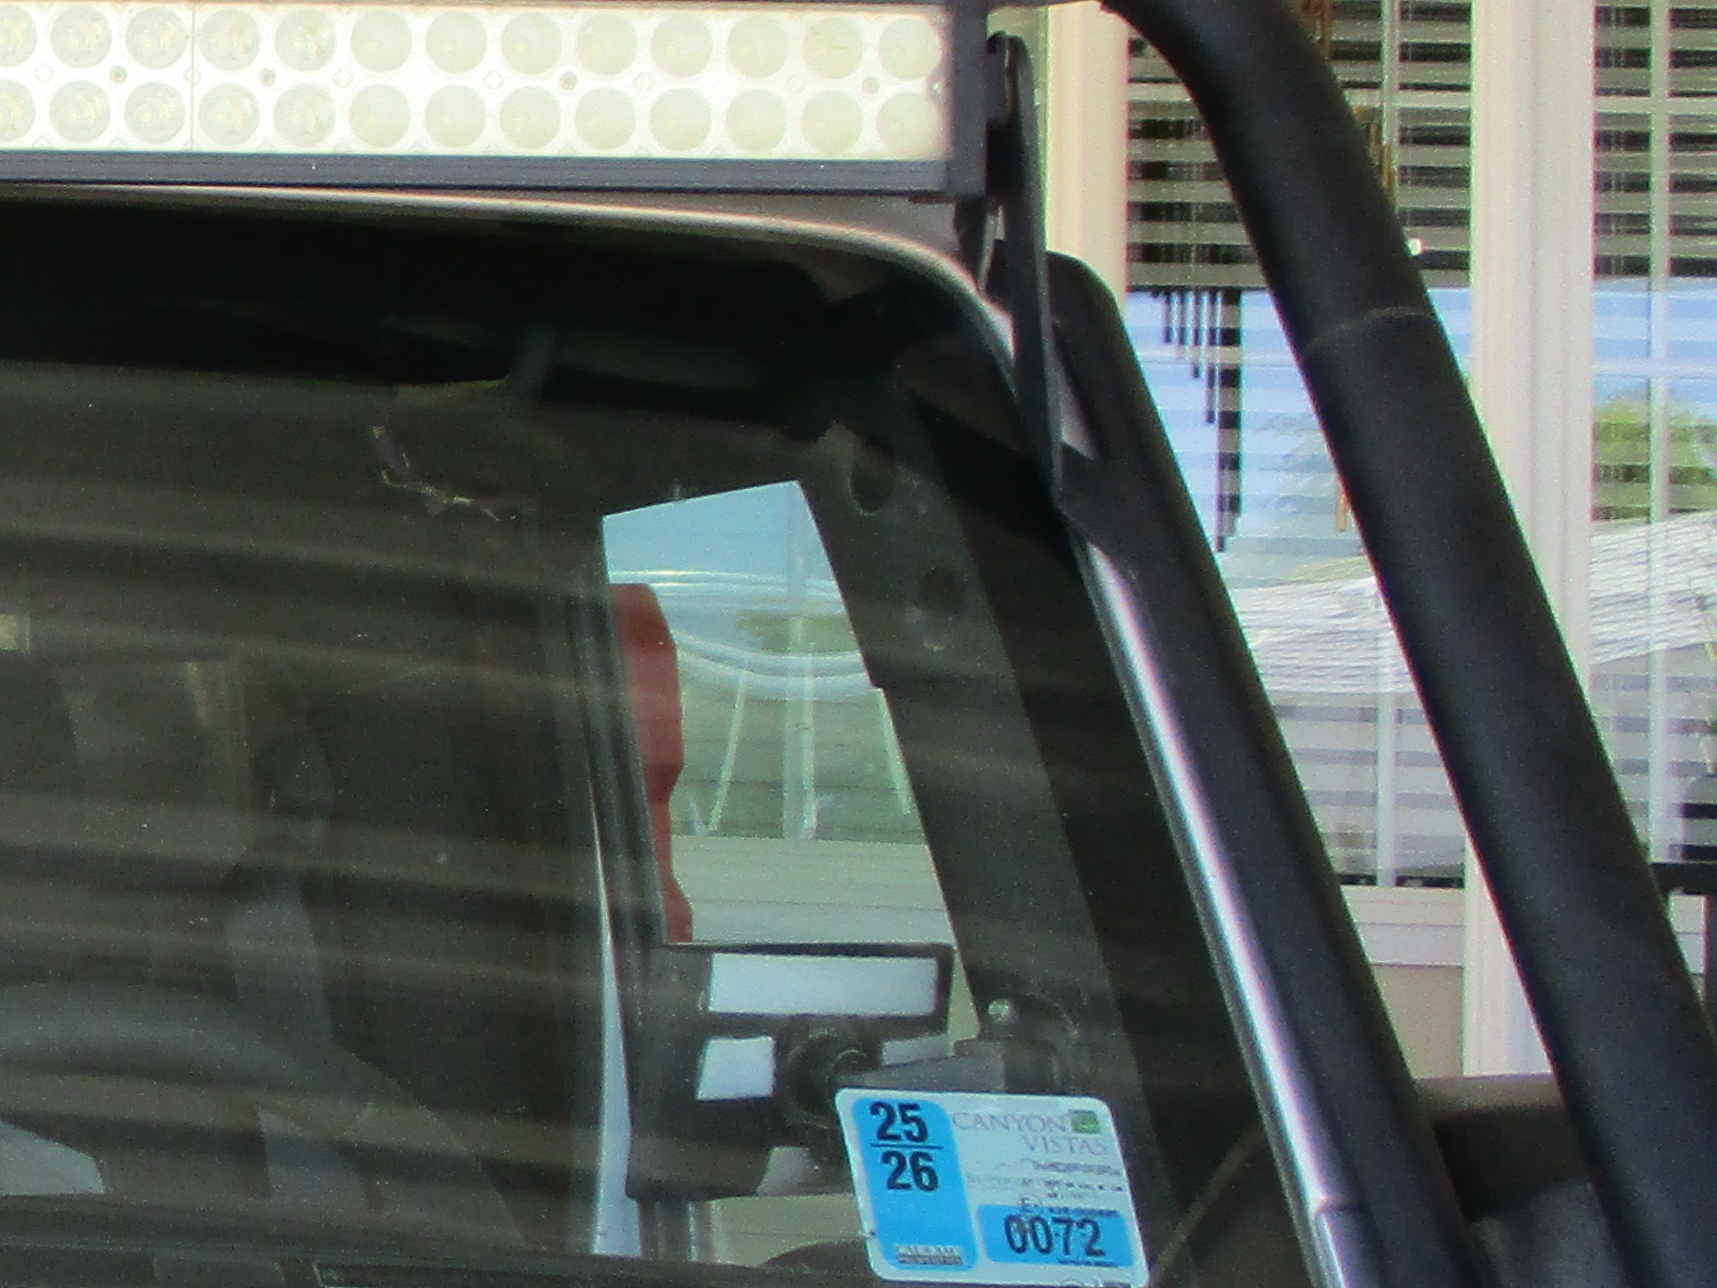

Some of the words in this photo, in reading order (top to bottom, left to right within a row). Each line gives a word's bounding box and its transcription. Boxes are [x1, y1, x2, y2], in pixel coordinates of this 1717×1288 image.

[870, 1102, 928, 1142] 25
[953, 1112, 1073, 1132] CANYON
[1020, 1135, 1107, 1156] VISTAS
[881, 1151, 939, 1191] 26
[1005, 1214, 1106, 1256] 0072
